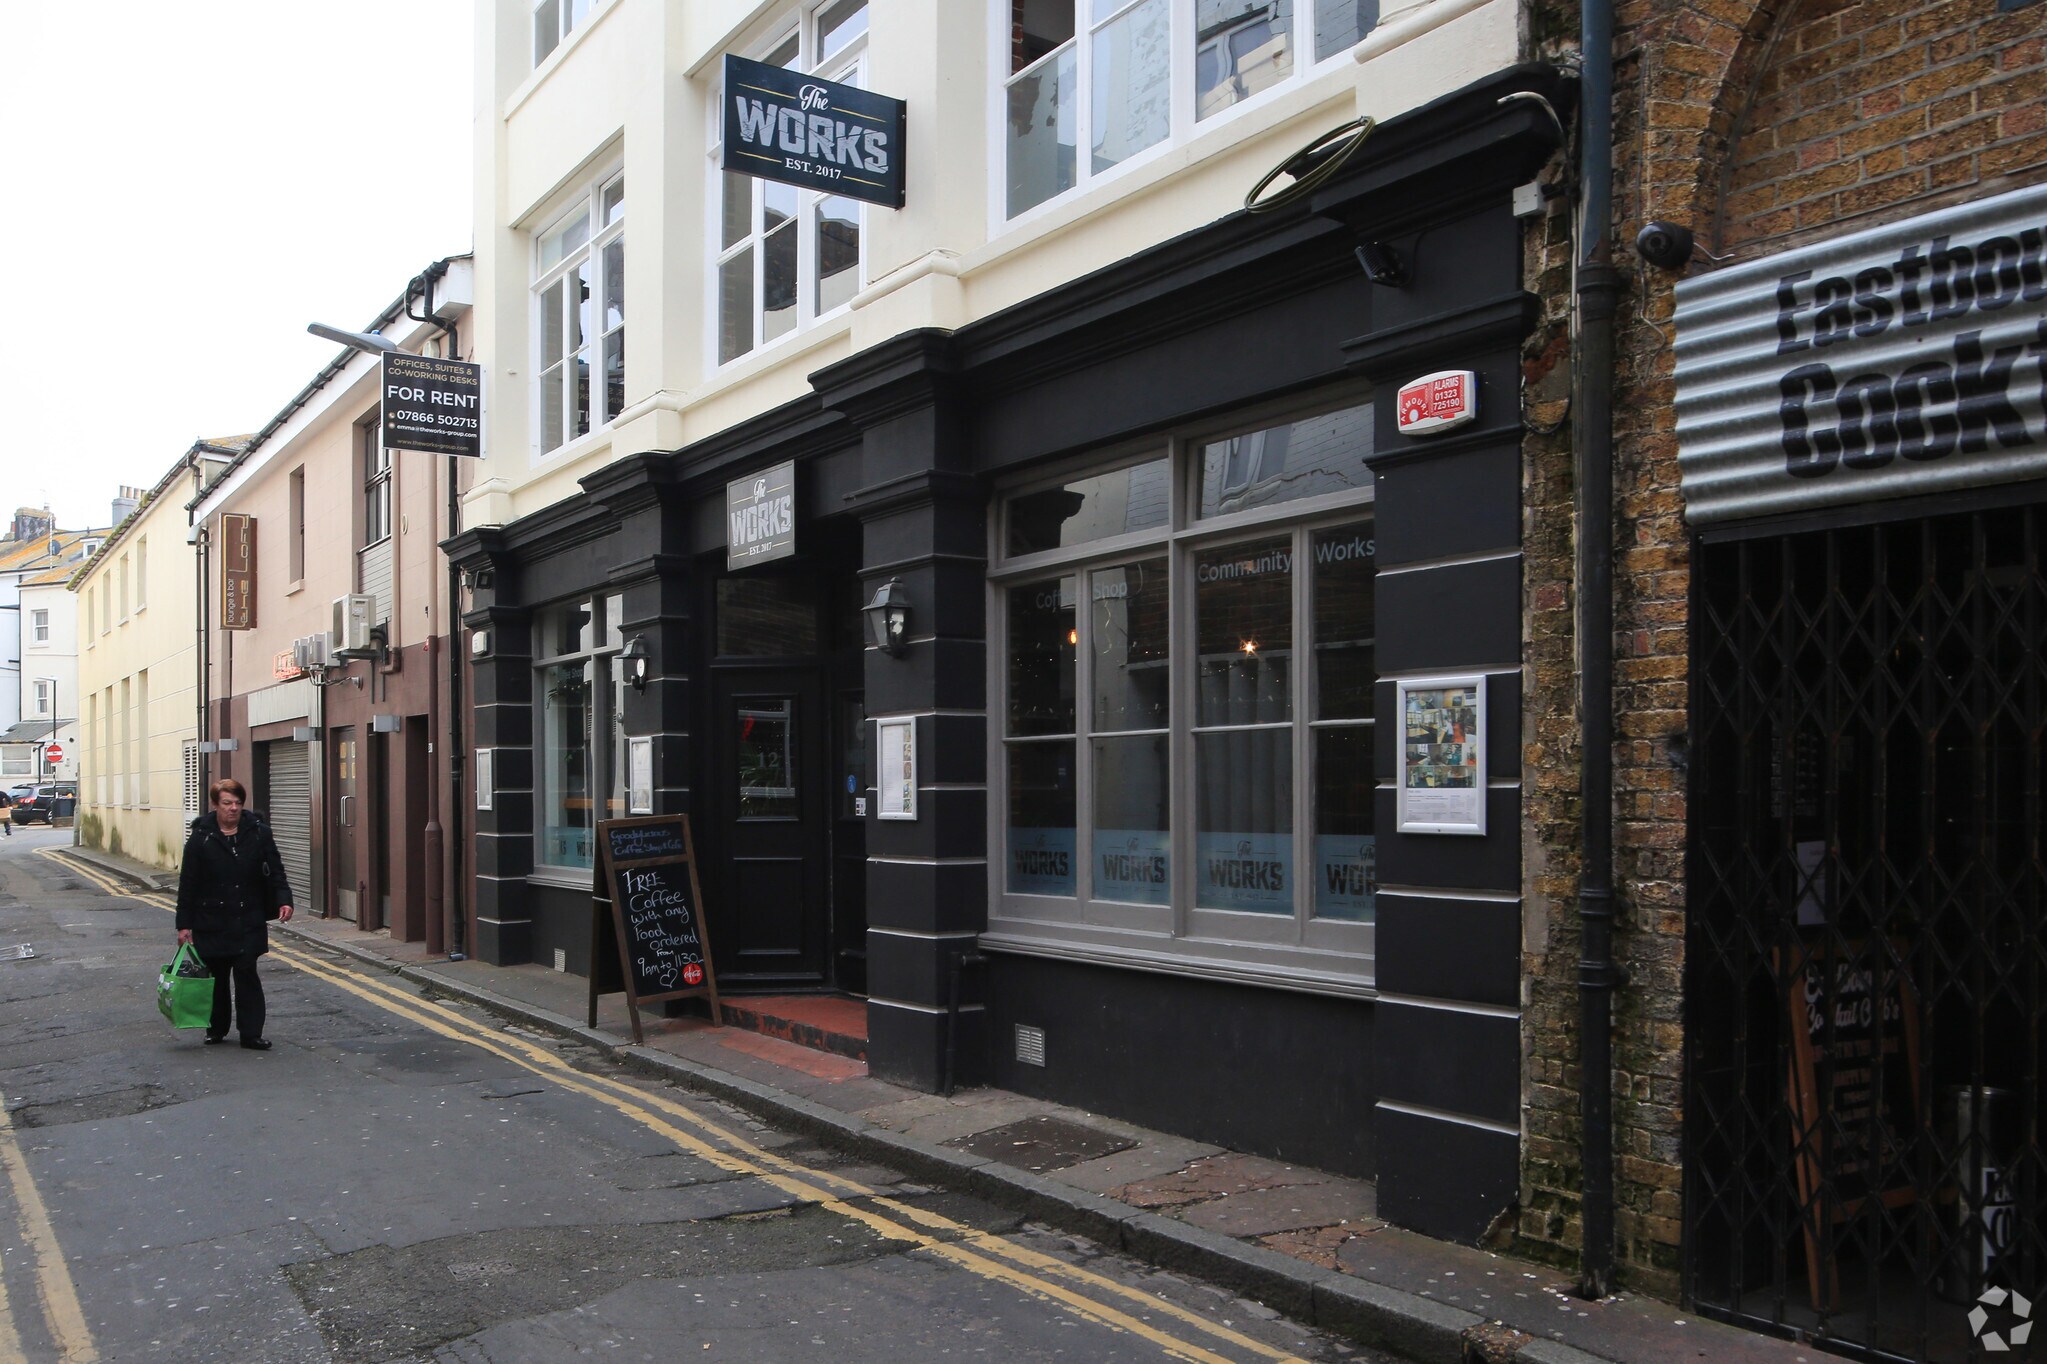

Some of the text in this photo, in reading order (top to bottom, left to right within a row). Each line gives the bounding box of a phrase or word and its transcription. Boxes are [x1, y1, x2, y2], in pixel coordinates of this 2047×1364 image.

[799, 84, 829, 111] The
[736, 96, 889, 174] WORKS
[785, 157, 841, 180] EST. 2017
[388, 367, 477, 385] CO-WORKING DESKS
[393, 358, 433, 371] OFFICES,
[435, 363, 464, 374] SUITES
[1434, 376, 1459, 391] ALARMS
[1435, 389, 1458, 401] 01323
[387, 385, 477, 408] FOR RENT
[1433, 398, 1460, 411] 725190
[397, 410, 477, 428] 07866 502713
[1400, 397, 1429, 422] ARMOURY
[730, 494, 792, 546] WORKS
[1198, 538, 1377, 583] Community Works
[1093, 581, 1128, 600] Shop
[758, 751, 780, 769] 12
[1014, 849, 1069, 877] WORKS
[1103, 854, 1166, 883] WORKS
[622, 868, 666, 894] FREE
[1208, 859, 1284, 891] WORKS
[629, 889, 685, 913] Coffee
[665, 904, 690, 924] any
